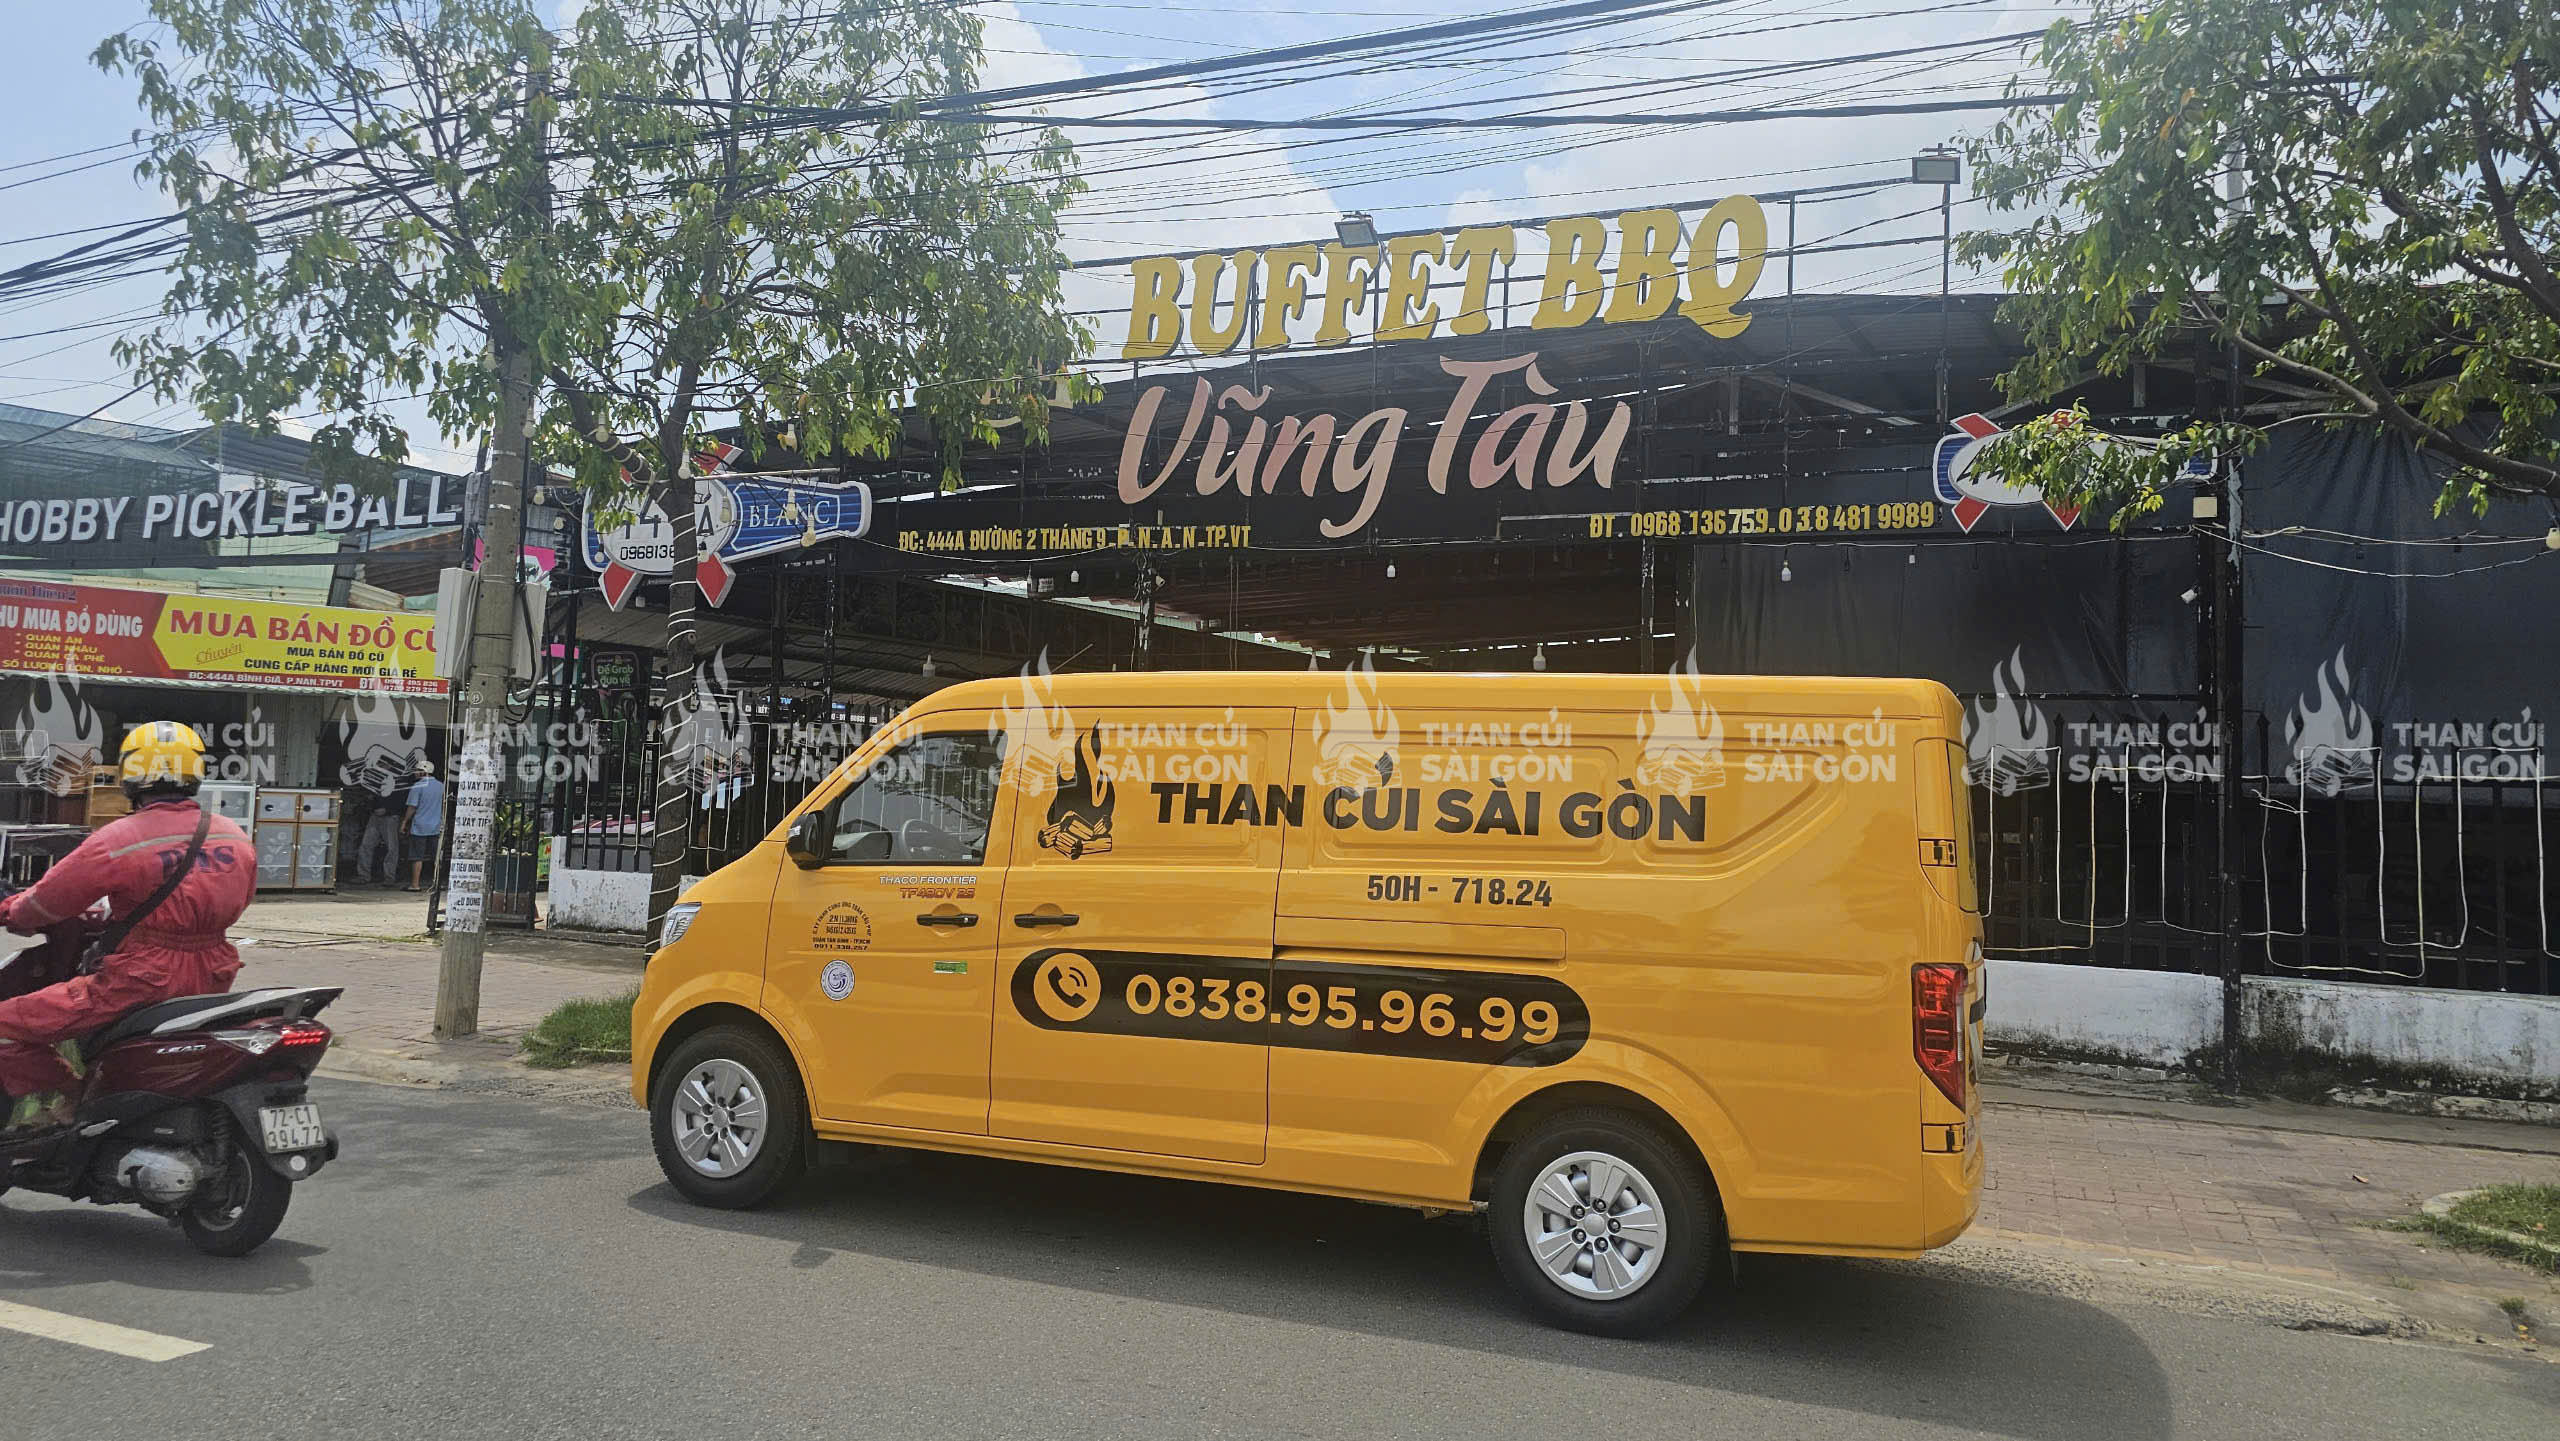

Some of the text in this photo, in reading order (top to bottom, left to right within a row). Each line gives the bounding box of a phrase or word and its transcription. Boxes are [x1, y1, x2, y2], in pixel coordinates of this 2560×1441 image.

[1121, 194, 1768, 361] BUFFET BBQ
[1117, 374, 1408, 539] Vũng
[1427, 352, 1632, 495] Tàu
[749, 501, 831, 528] BLANC
[1878, 501, 1935, 529] 9989
[926, 529, 965, 551] 444A
[969, 525, 1023, 551] ĐƯỜNG
[1026, 528, 1037, 550] 2
[1040, 523, 1093, 550] THÁNG
[22, 608, 61, 632] MUA
[95, 609, 144, 638] DÙNG
[170, 609, 257, 639] MUA
[268, 613, 339, 645] BÁN
[347, 616, 396, 648] ĐỒ
[286, 646, 315, 658] MUA
[318, 647, 345, 660] BÁN
[244, 658, 280, 670] CUNG
[284, 660, 310, 672] CẤP
[313, 662, 348, 675] HÀNG
[402, 666, 417, 678] RẺ
[611, 664, 634, 674] Grab
[467, 781, 481, 791] VAY
[1150, 782, 1306, 828] THAN
[1434, 777, 1541, 836] SÀI
[1559, 777, 1706, 842] GÒN
[879, 875, 977, 885] THACO FRONTIER
[1367, 875, 1422, 902] 50H
[1451, 877, 1553, 908] 718.24
[1125, 973, 1560, 1045] 0838.95.96.99
